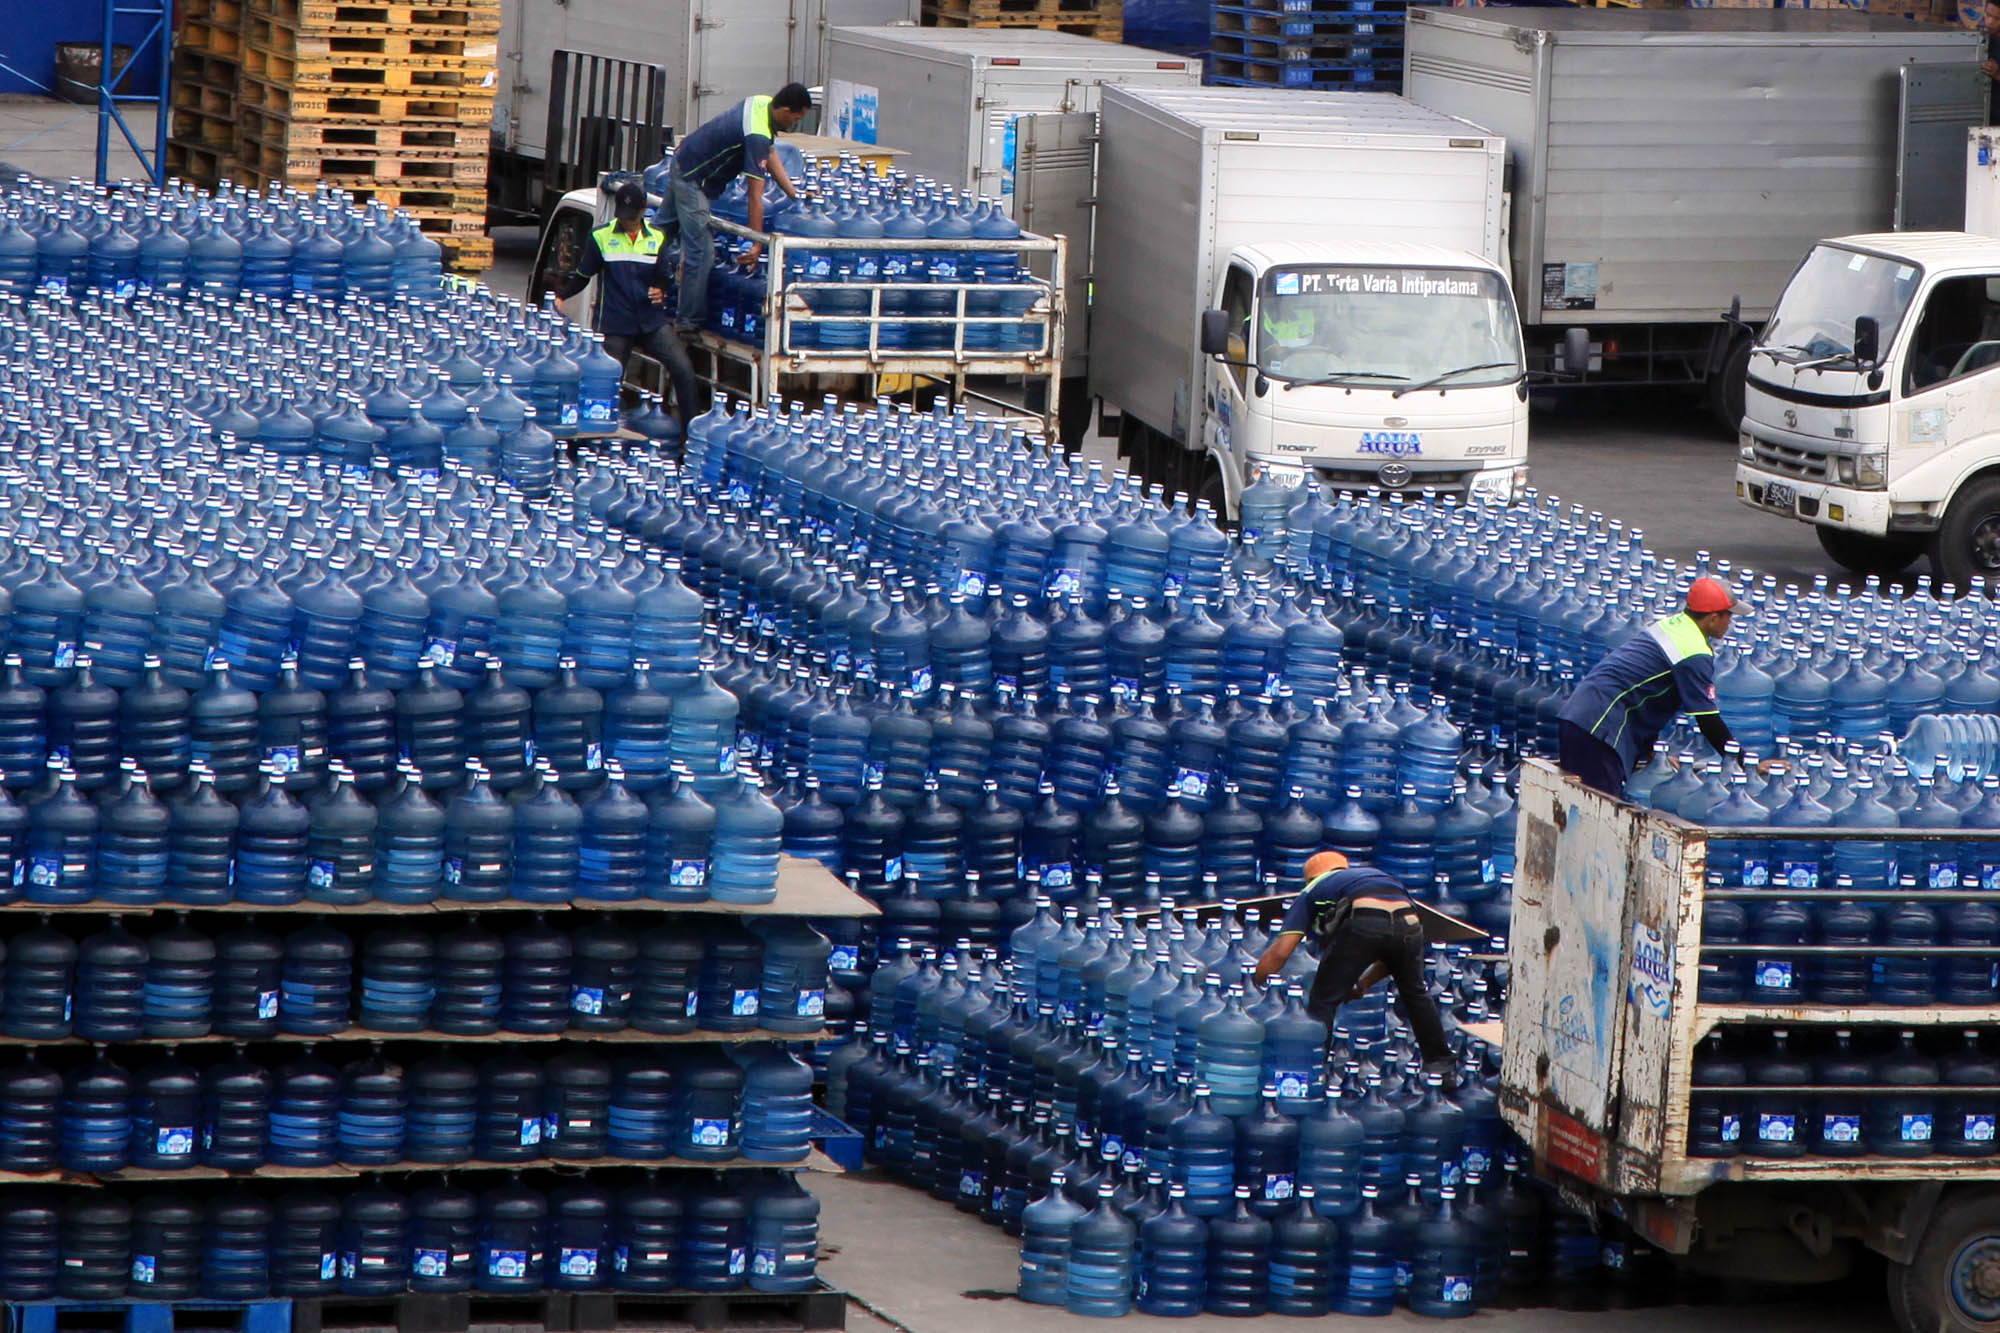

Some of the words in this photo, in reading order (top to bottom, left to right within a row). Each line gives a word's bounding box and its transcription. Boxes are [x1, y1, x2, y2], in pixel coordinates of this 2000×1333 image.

[1302, 274, 1322, 292] PT.
[1326, 274, 1359, 292] Tirta
[1362, 274, 1398, 293] Varia
[1401, 276, 1478, 298] Intipratama
[1356, 432, 1423, 458] AQUA
